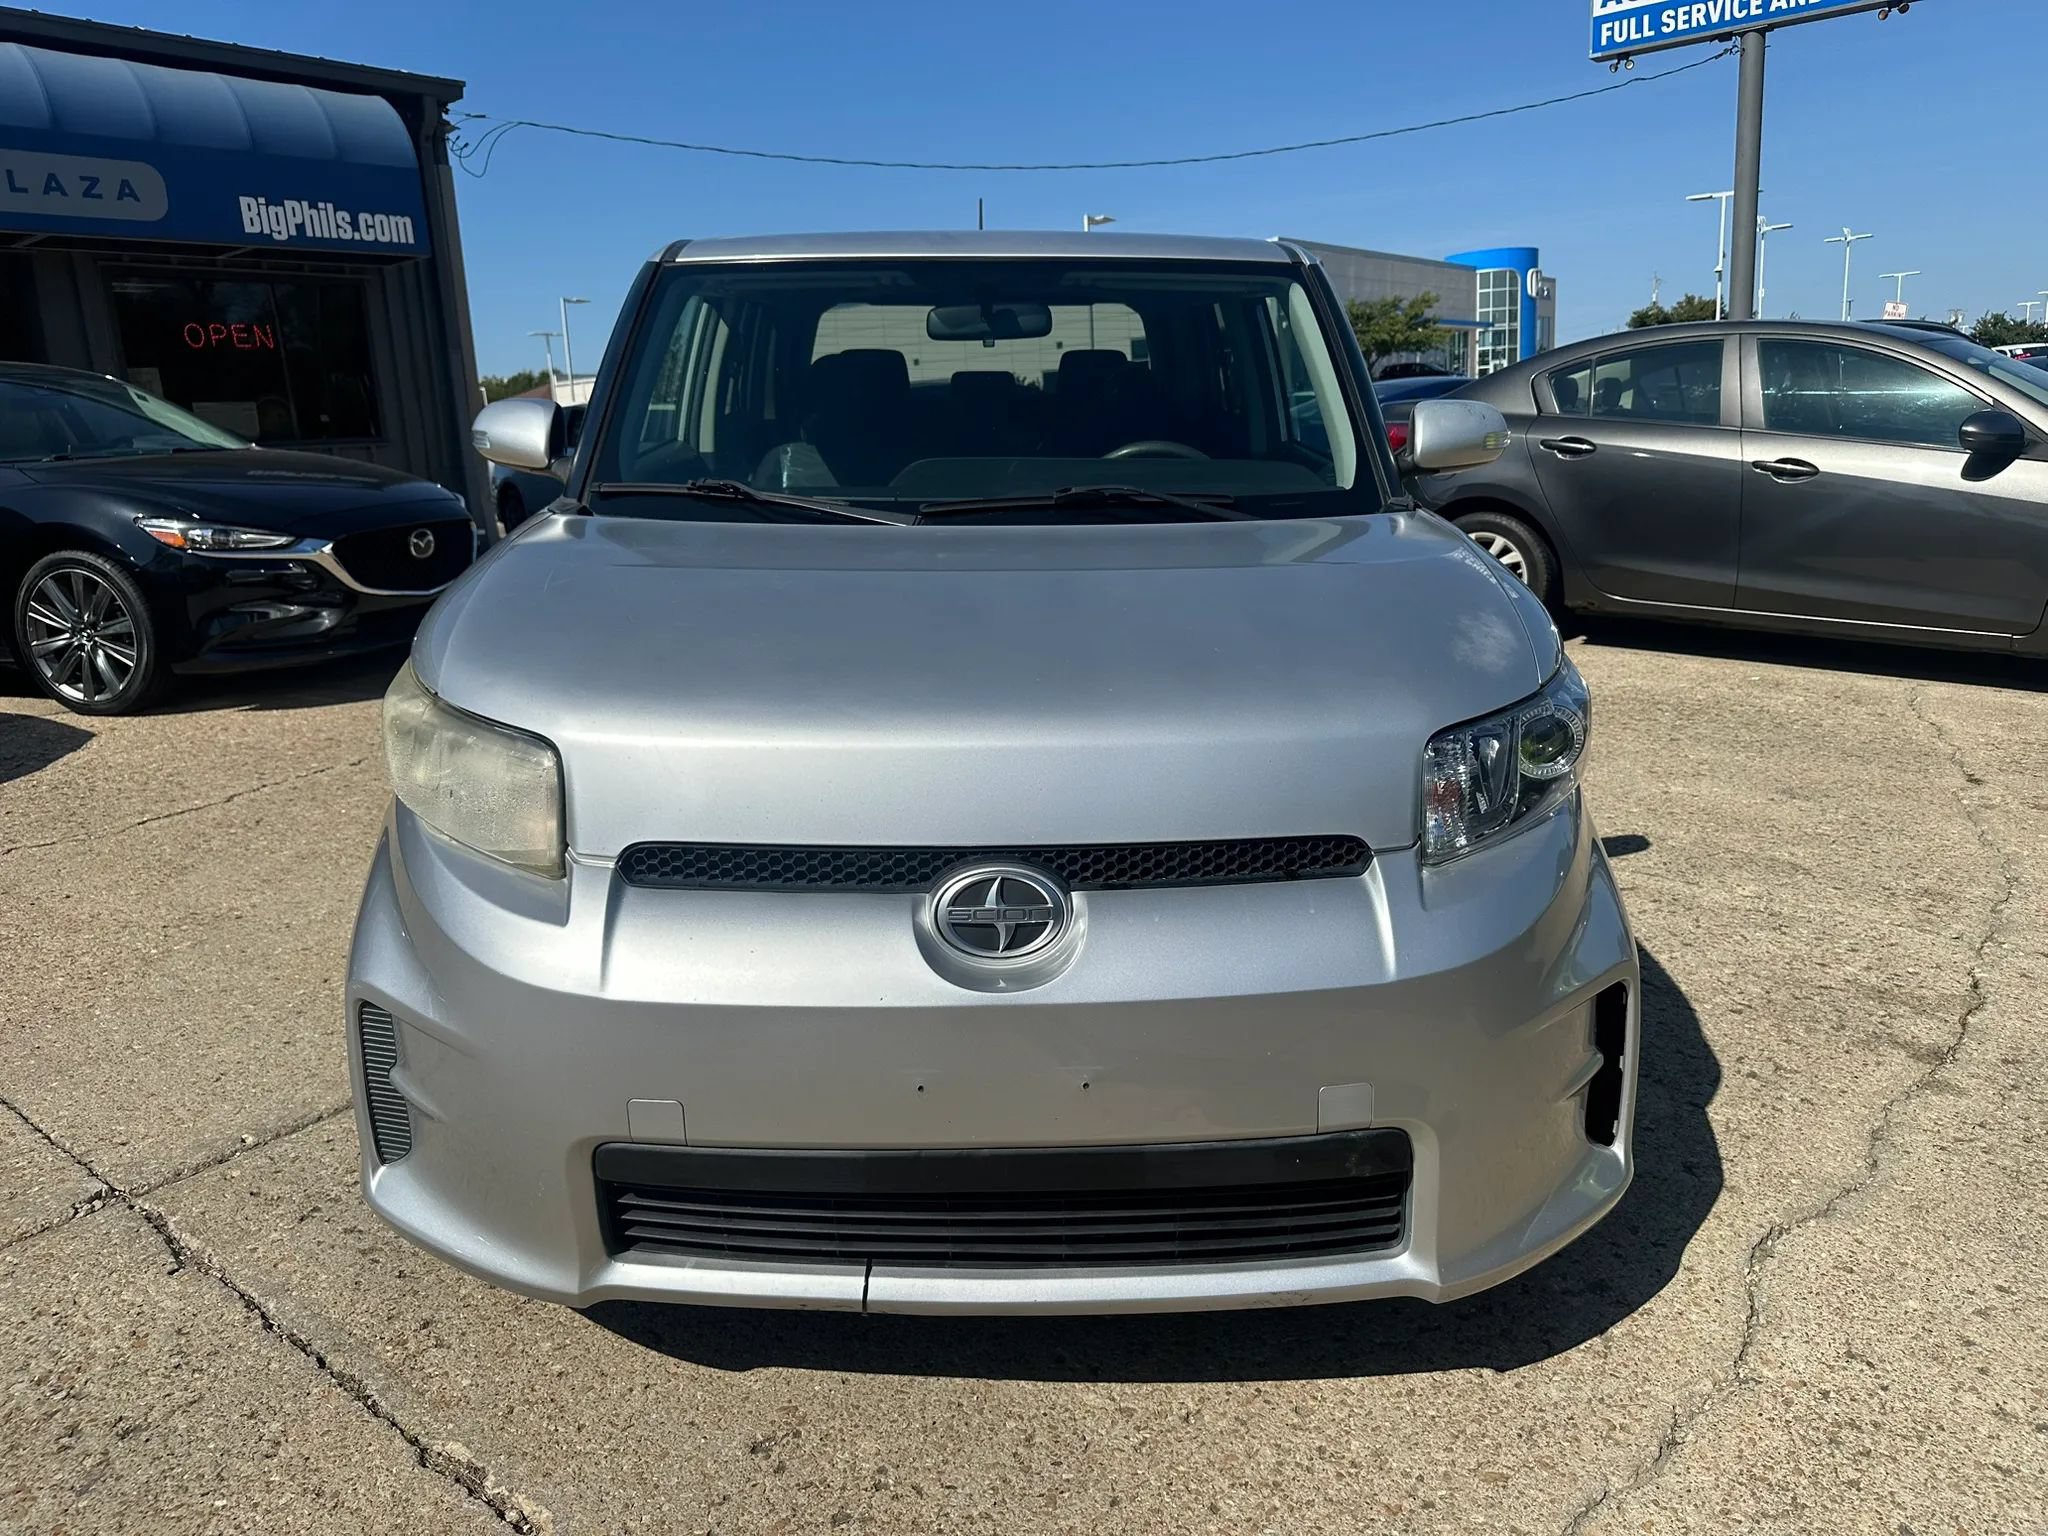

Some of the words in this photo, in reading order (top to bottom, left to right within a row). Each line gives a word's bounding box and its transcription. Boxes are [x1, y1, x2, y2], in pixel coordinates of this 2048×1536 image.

[1600, 14, 1655, 46] FULL
[1661, 0, 1763, 34] SERVICE
[239, 196, 415, 244] BigPhils.com
[184, 323, 274, 349] OPEN
